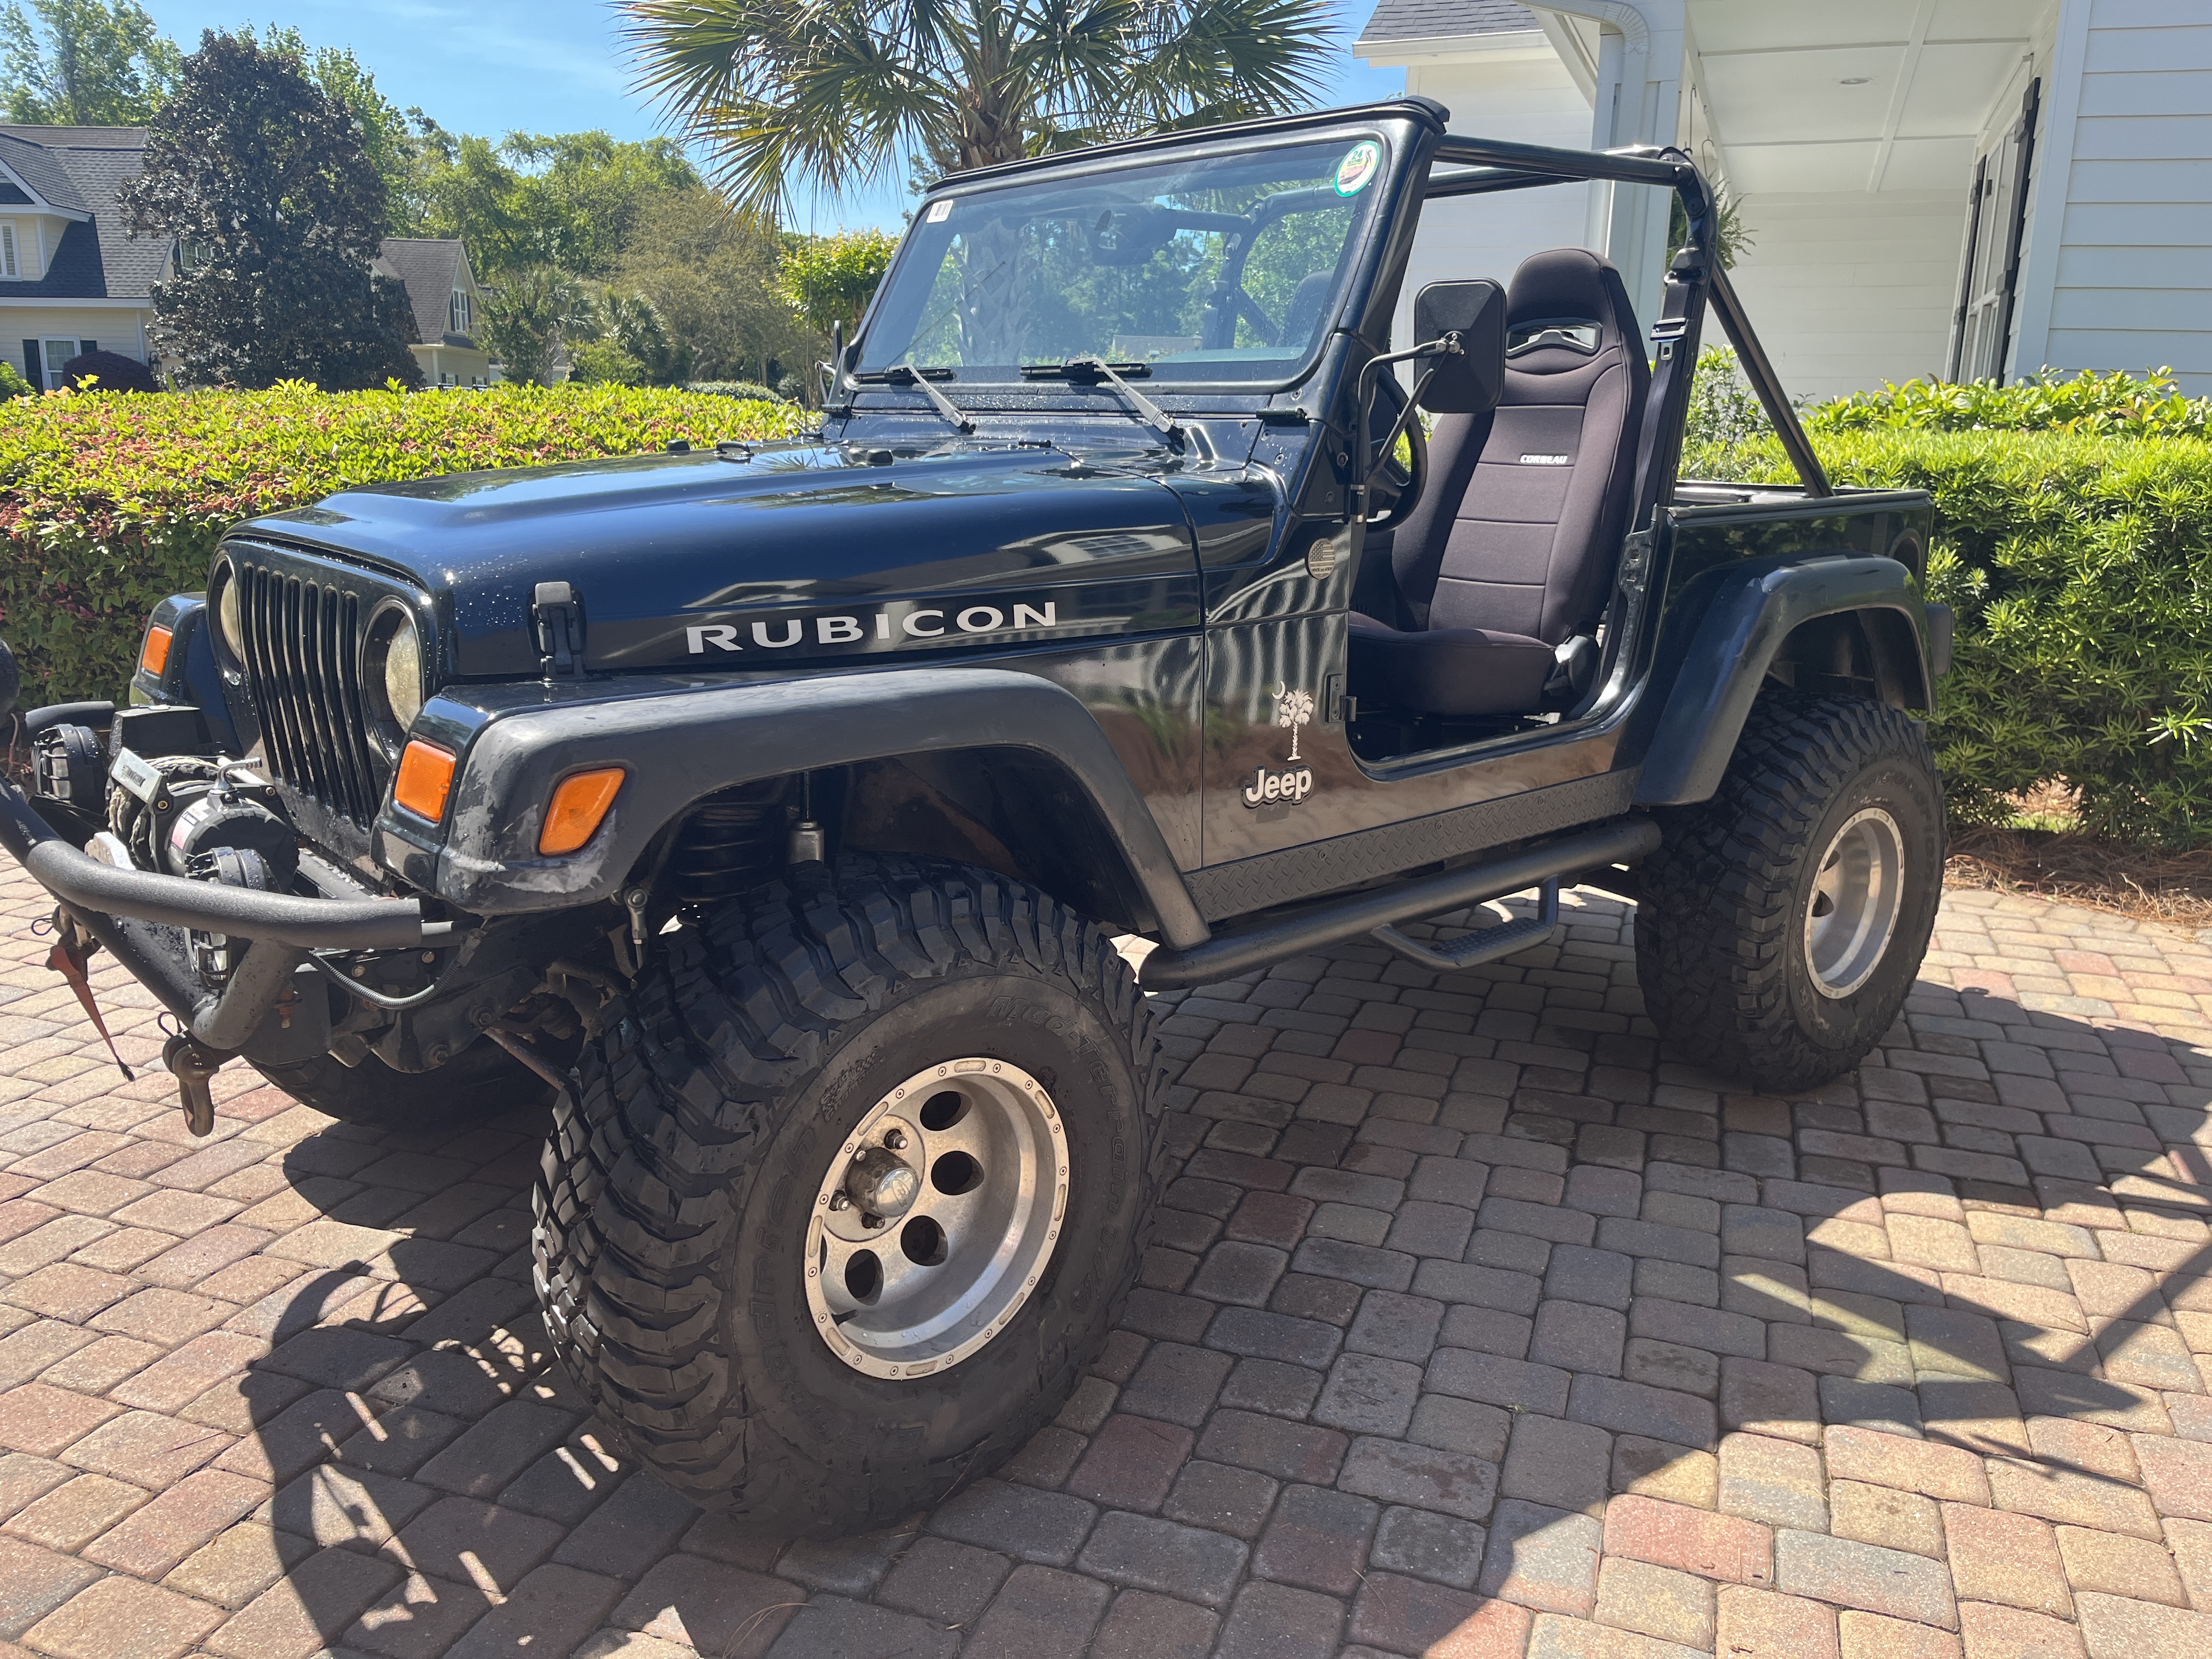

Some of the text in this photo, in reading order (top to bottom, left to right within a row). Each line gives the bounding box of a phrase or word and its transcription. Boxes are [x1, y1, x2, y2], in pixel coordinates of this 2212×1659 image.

[1520, 454, 1567, 464] CORBEAU
[686, 602, 1056, 654] RUBICON
[1245, 769, 1312, 802] Jeep
